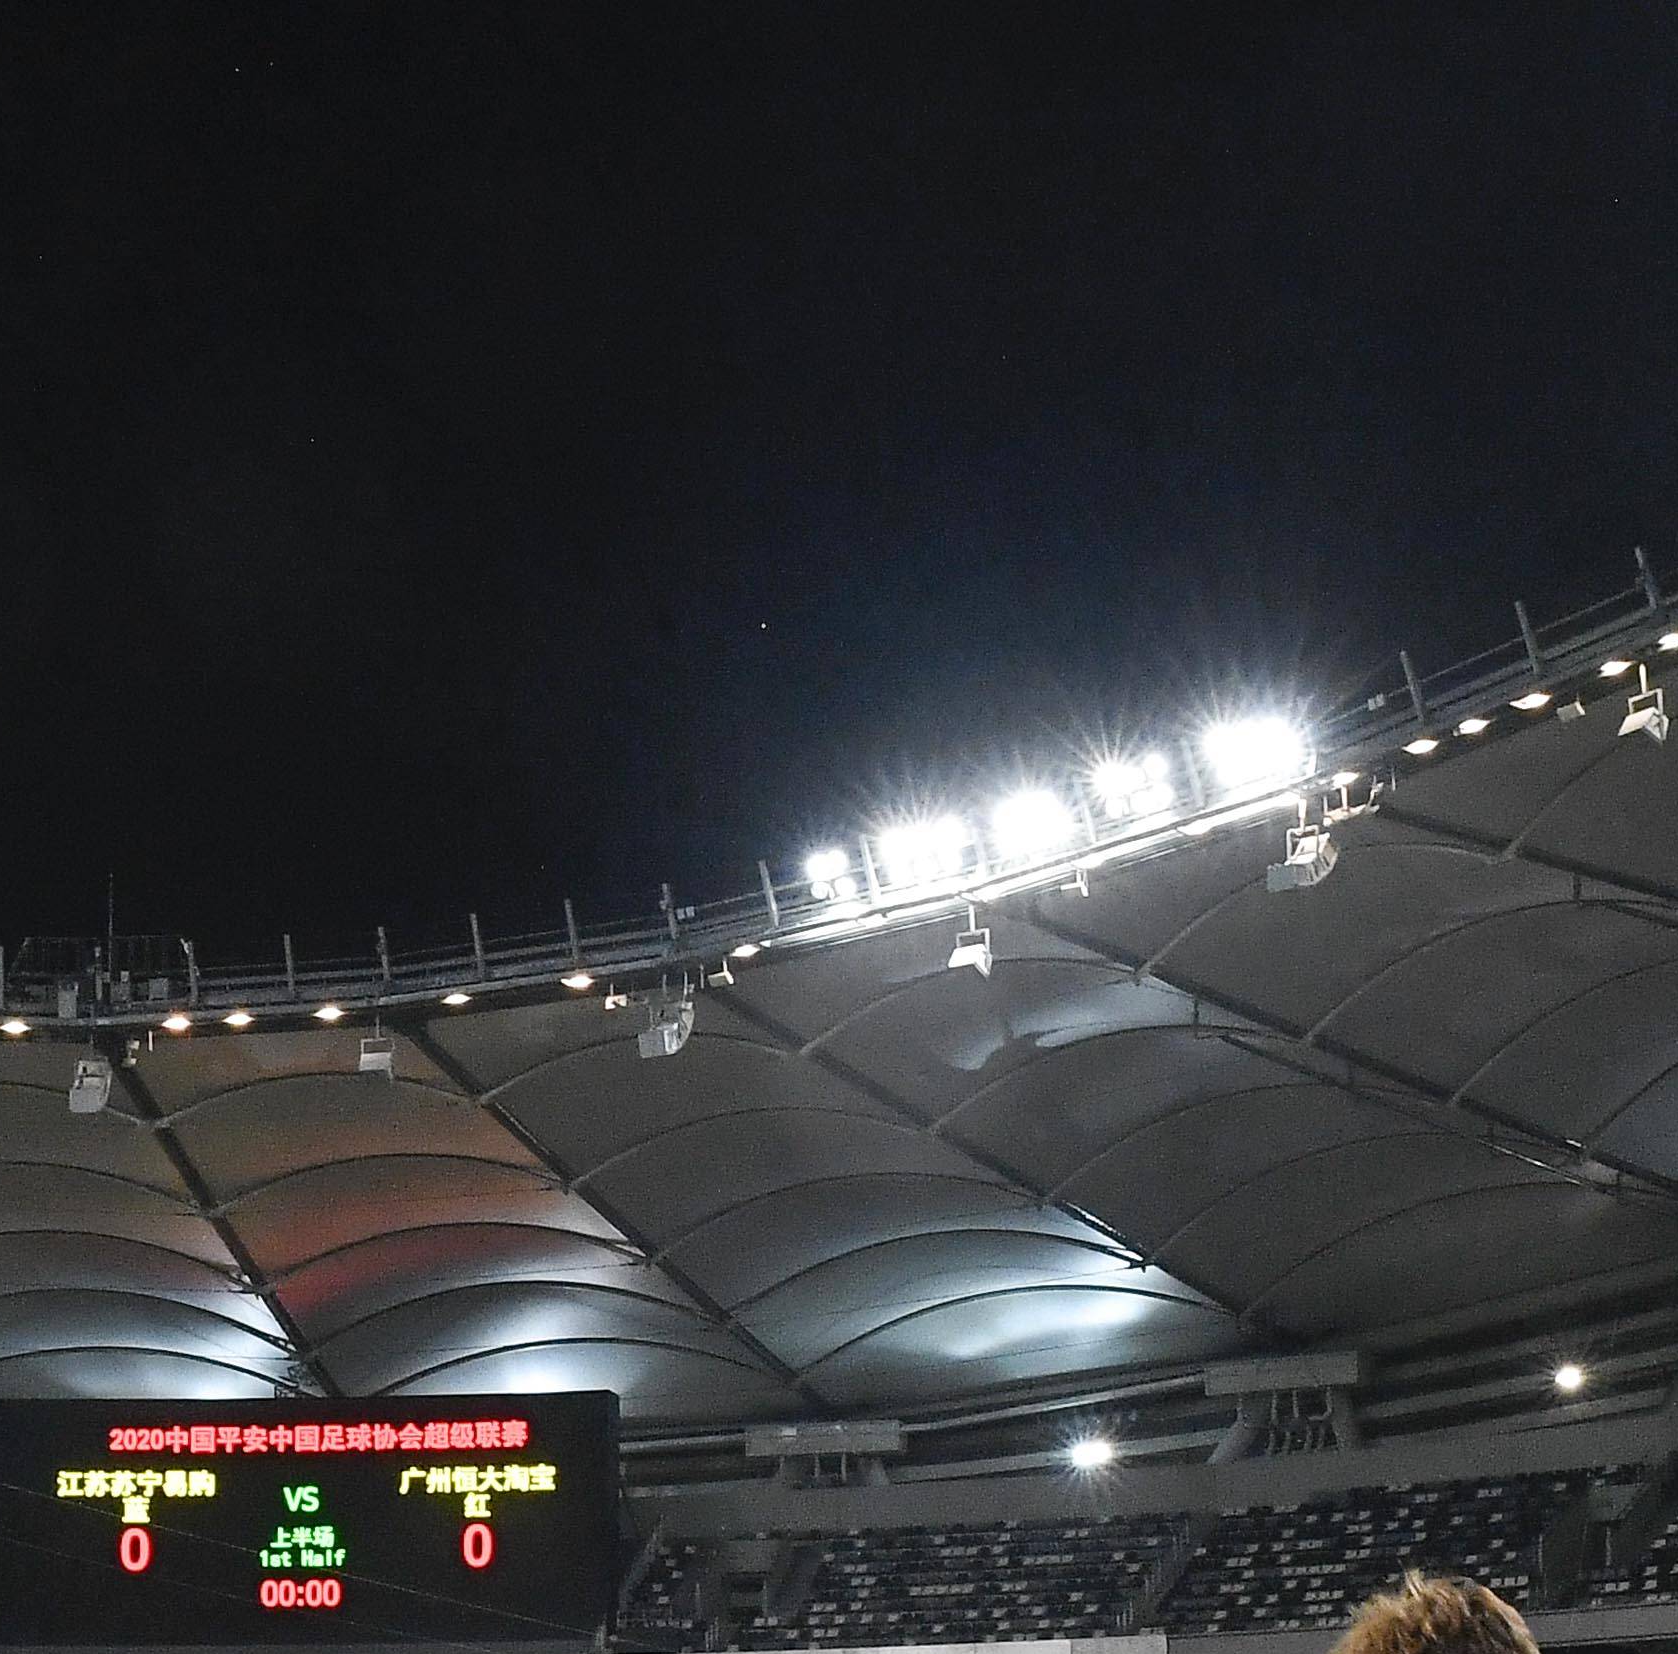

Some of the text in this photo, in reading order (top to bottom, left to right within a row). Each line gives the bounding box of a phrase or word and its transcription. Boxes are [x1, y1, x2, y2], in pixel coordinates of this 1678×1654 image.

[109, 1420, 528, 1453] 2020中国平安中国足球协会超级联赛
[56, 1469, 216, 1498] 江苏苏宁易购
[399, 1463, 556, 1494] 广州恒大淘宝
[283, 1486, 320, 1512] VS
[463, 1492, 492, 1518] 红
[120, 1527, 150, 1572] 0
[270, 1526, 335, 1548] 上半场
[463, 1523, 493, 1568] 0
[259, 1548, 346, 1567] 1st Half
[260, 1579, 341, 1607] 00:00
